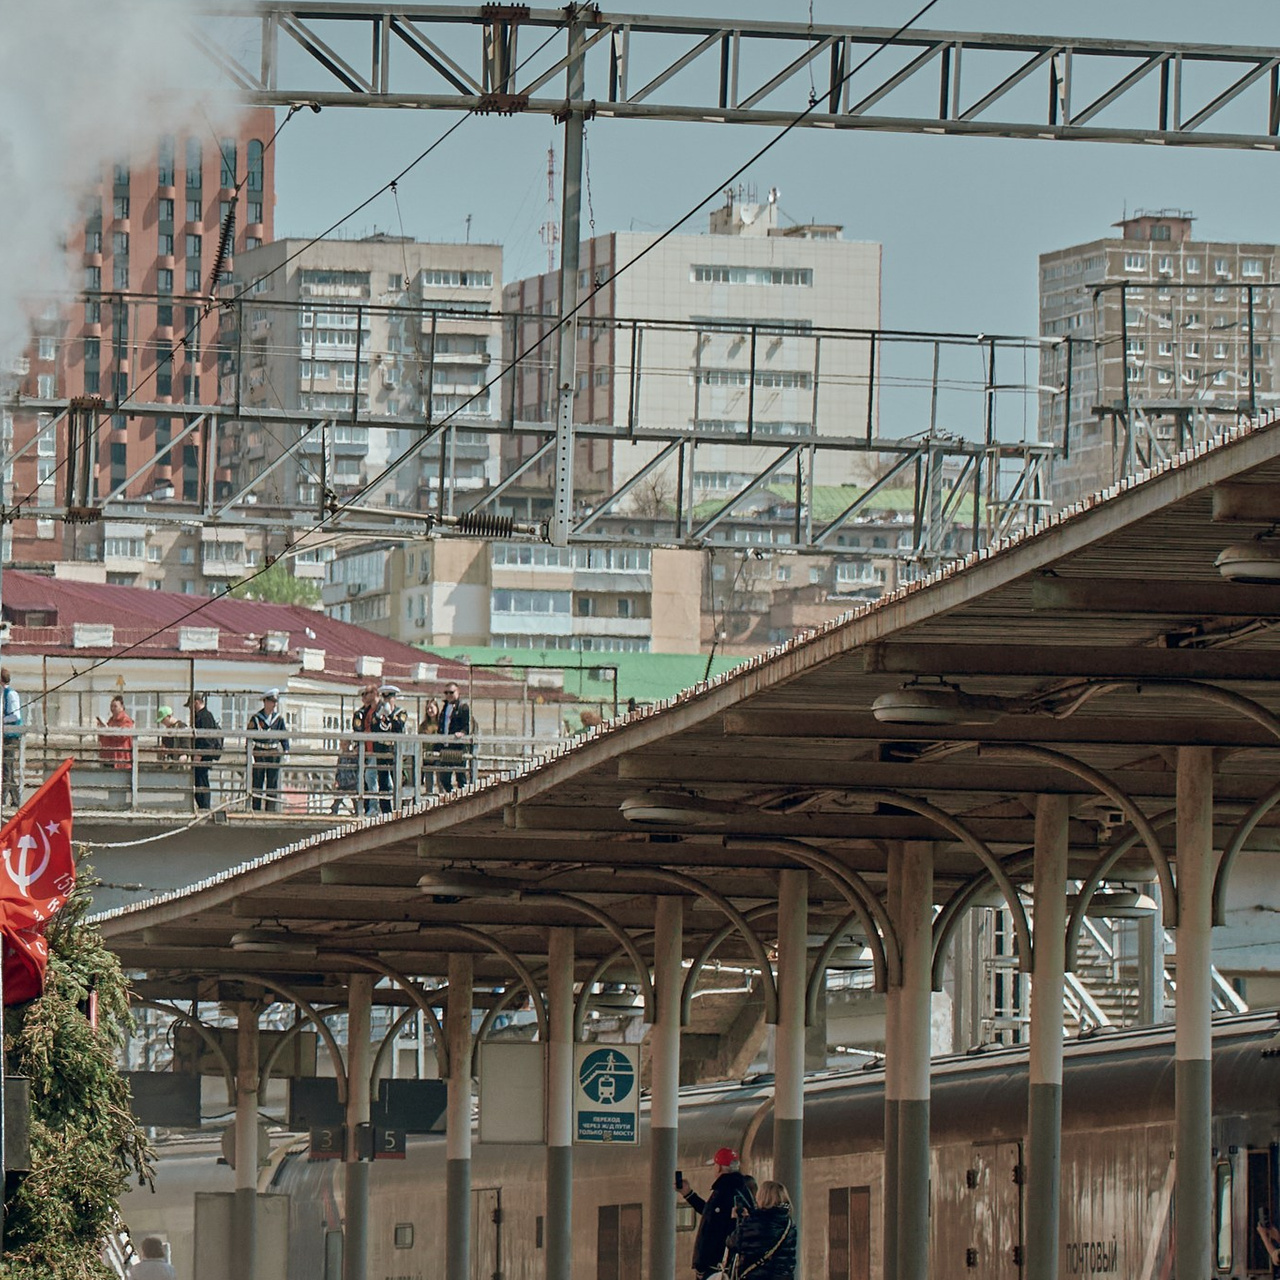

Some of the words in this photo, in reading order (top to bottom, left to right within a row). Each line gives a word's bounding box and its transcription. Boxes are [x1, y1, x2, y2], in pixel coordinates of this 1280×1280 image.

[321, 1130, 332, 1148] 3
[384, 1130, 396, 1149] 5
[1065, 1233, 1118, 1275] ПОЧТОВЫЙ
